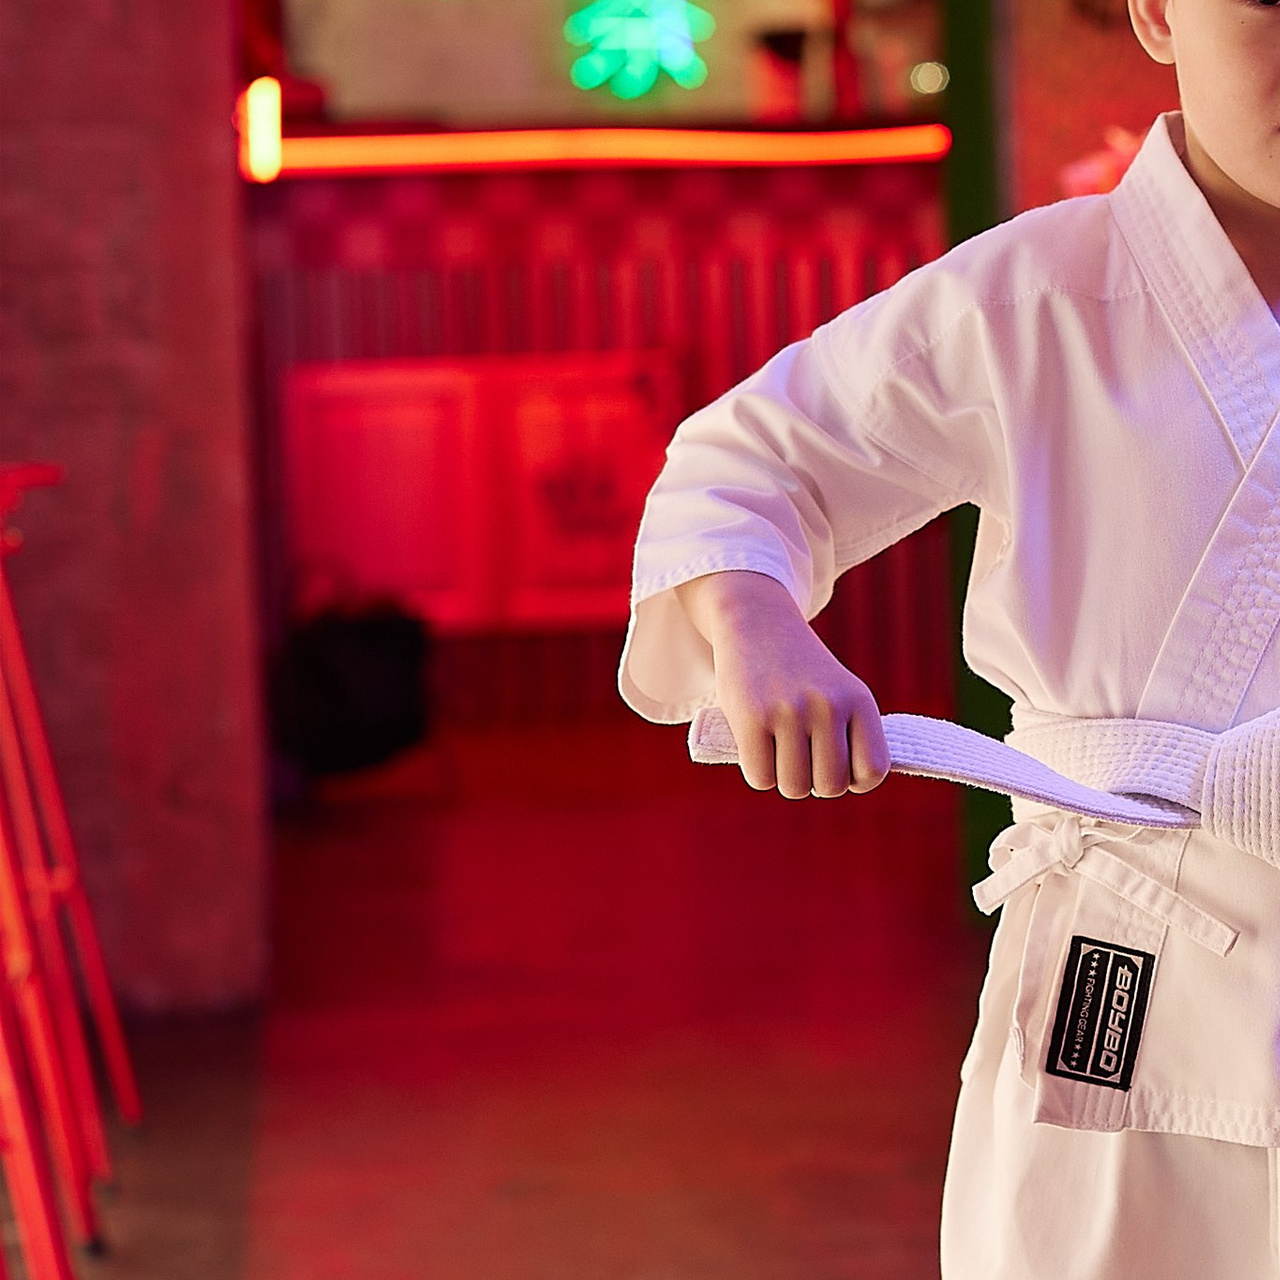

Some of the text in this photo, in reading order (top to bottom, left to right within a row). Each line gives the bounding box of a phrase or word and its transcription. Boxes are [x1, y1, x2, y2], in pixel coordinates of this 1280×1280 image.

[1074, 977, 1096, 1043] FIGHTING GEAR
[1099, 964, 1133, 1072] BOYBO
